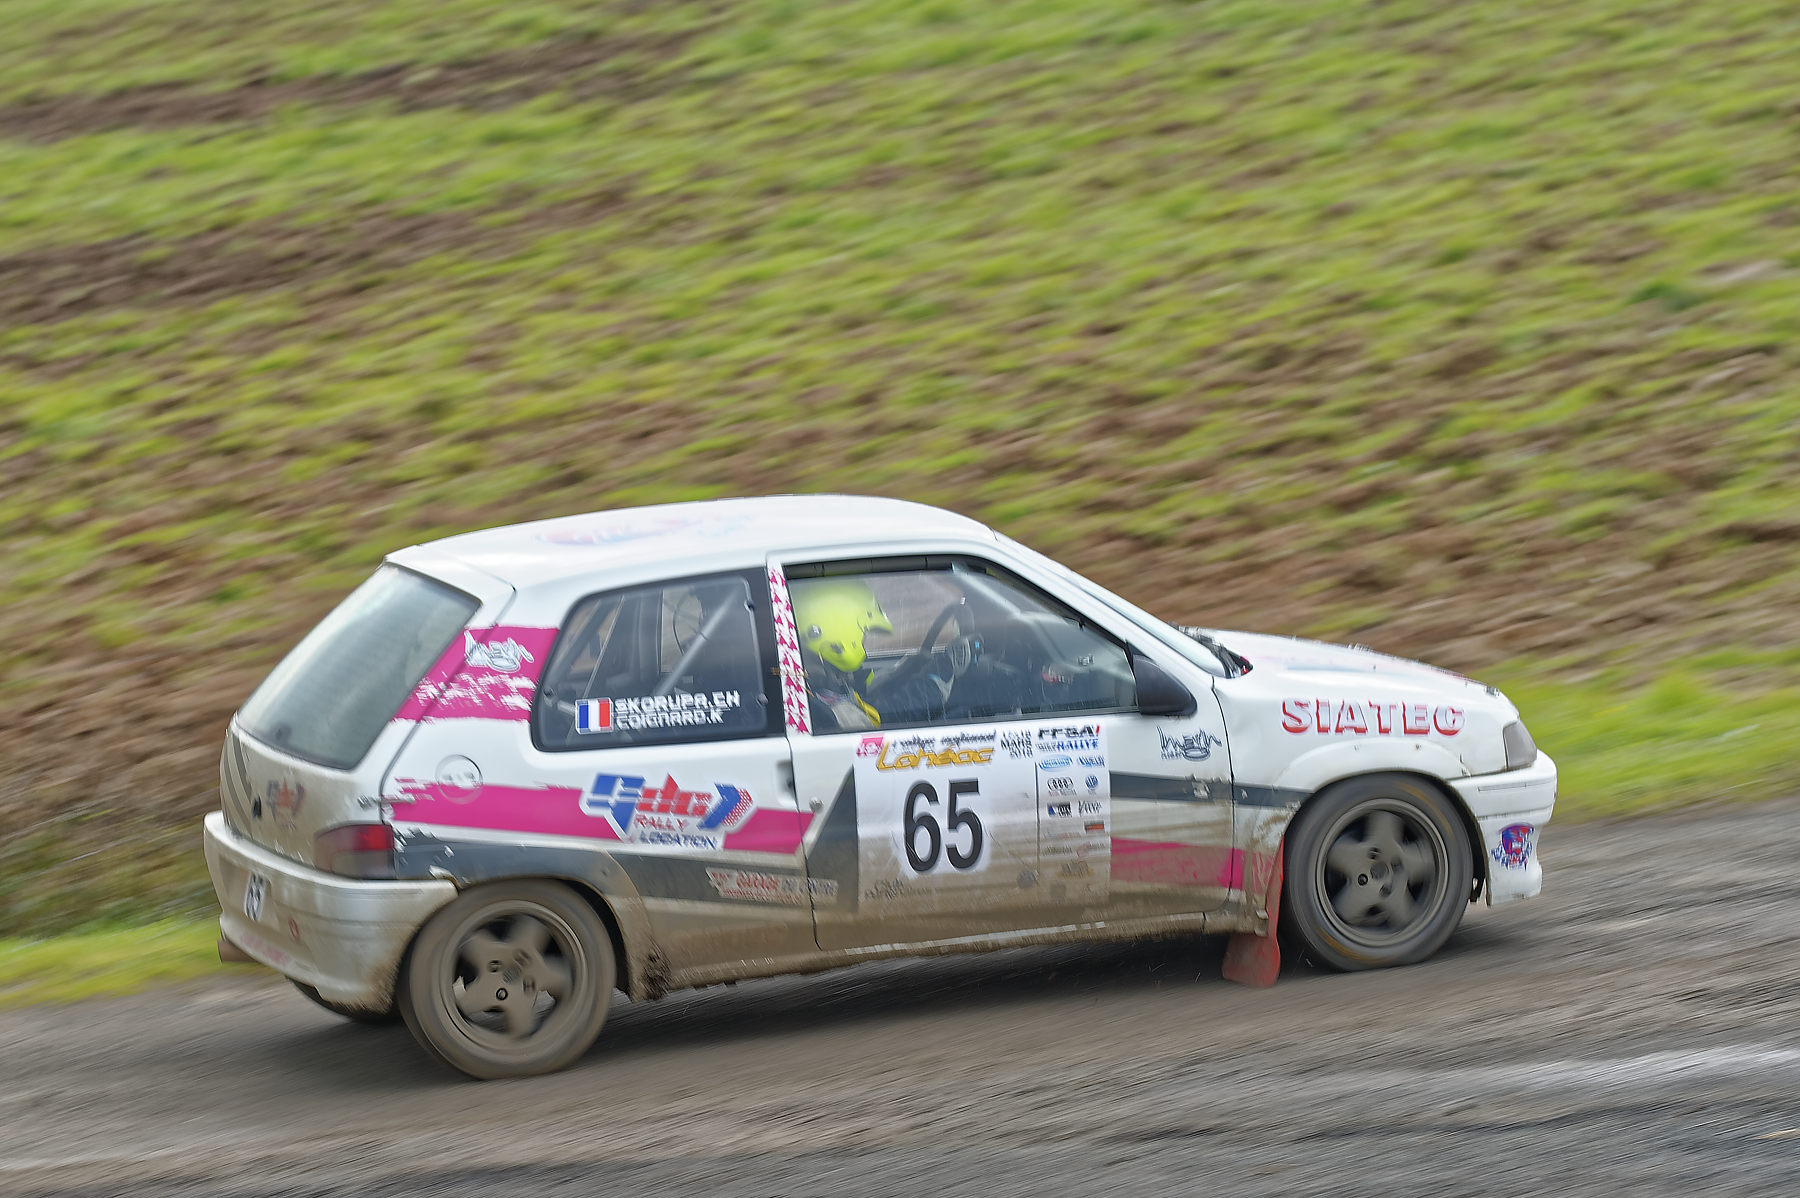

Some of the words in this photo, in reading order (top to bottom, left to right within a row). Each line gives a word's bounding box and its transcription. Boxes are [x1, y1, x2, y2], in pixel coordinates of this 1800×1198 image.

[1281, 697, 1466, 737] SIATEC
[634, 814, 690, 832] RALLY
[903, 777, 984, 873] 65
[640, 831, 718, 850] LOCATION
